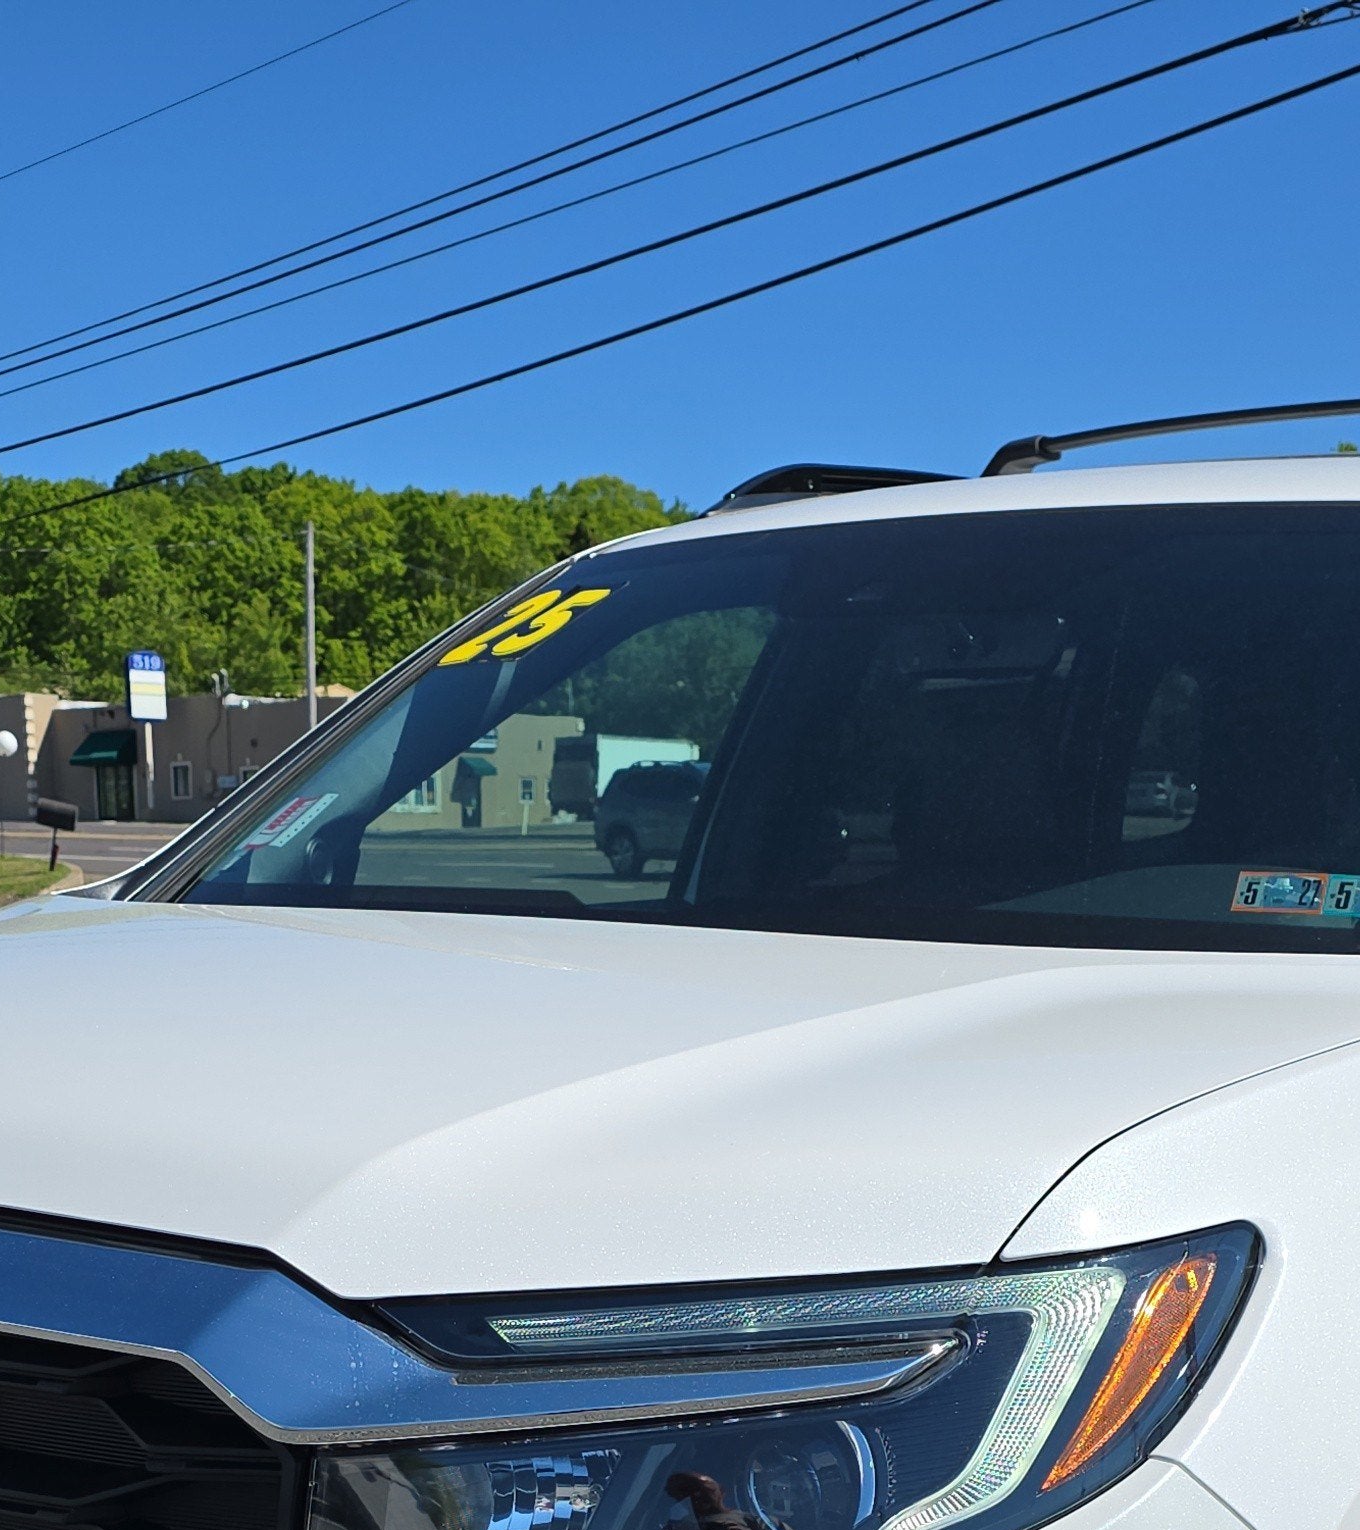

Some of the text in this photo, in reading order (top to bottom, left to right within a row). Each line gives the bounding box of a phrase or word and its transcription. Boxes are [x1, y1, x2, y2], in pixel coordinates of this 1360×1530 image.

[437, 588, 612, 667] 25
[1243, 879, 1323, 906] 5 27
[1334, 881, 1355, 910] 5
